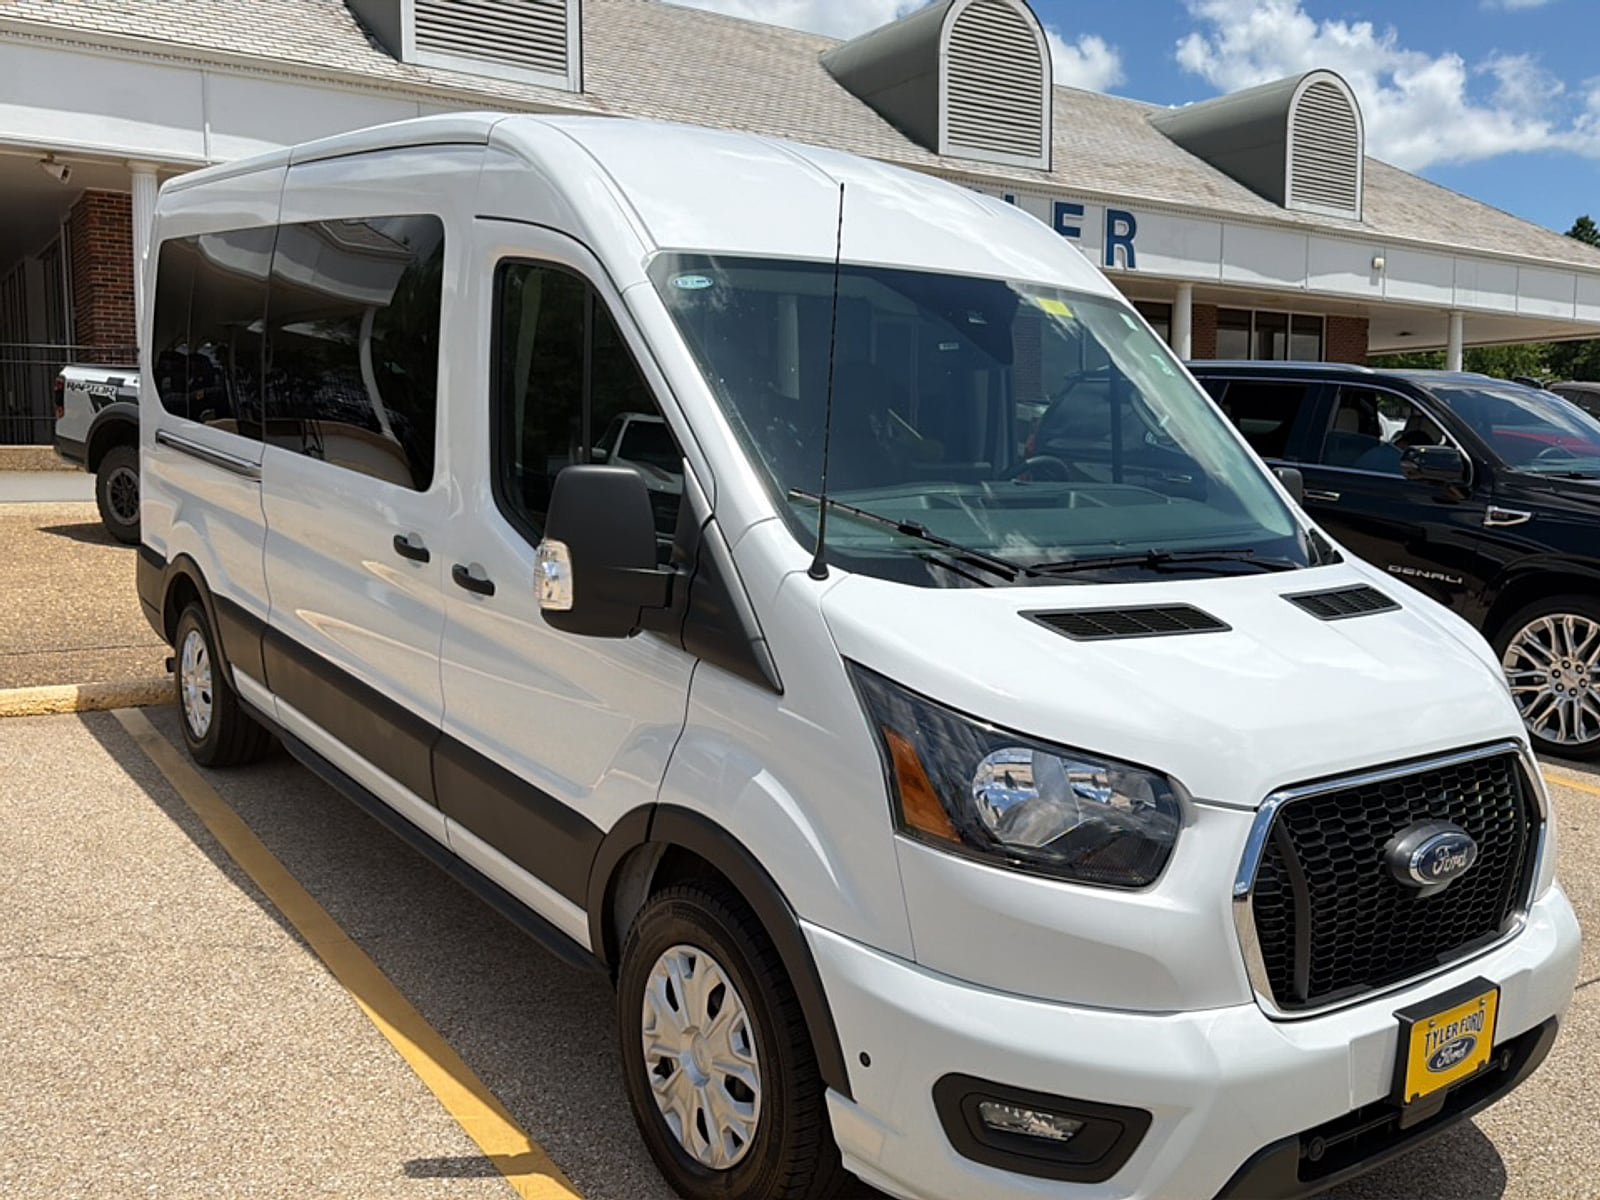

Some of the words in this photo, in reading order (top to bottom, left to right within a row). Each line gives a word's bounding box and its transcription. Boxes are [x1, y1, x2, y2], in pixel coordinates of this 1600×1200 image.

[1387, 564, 1463, 584] DENALI
[1432, 842, 1468, 875] Ford
[1425, 1021, 1459, 1059] TYLER
[1460, 1009, 1485, 1034] FORD
[1436, 1040, 1469, 1069] Ford
